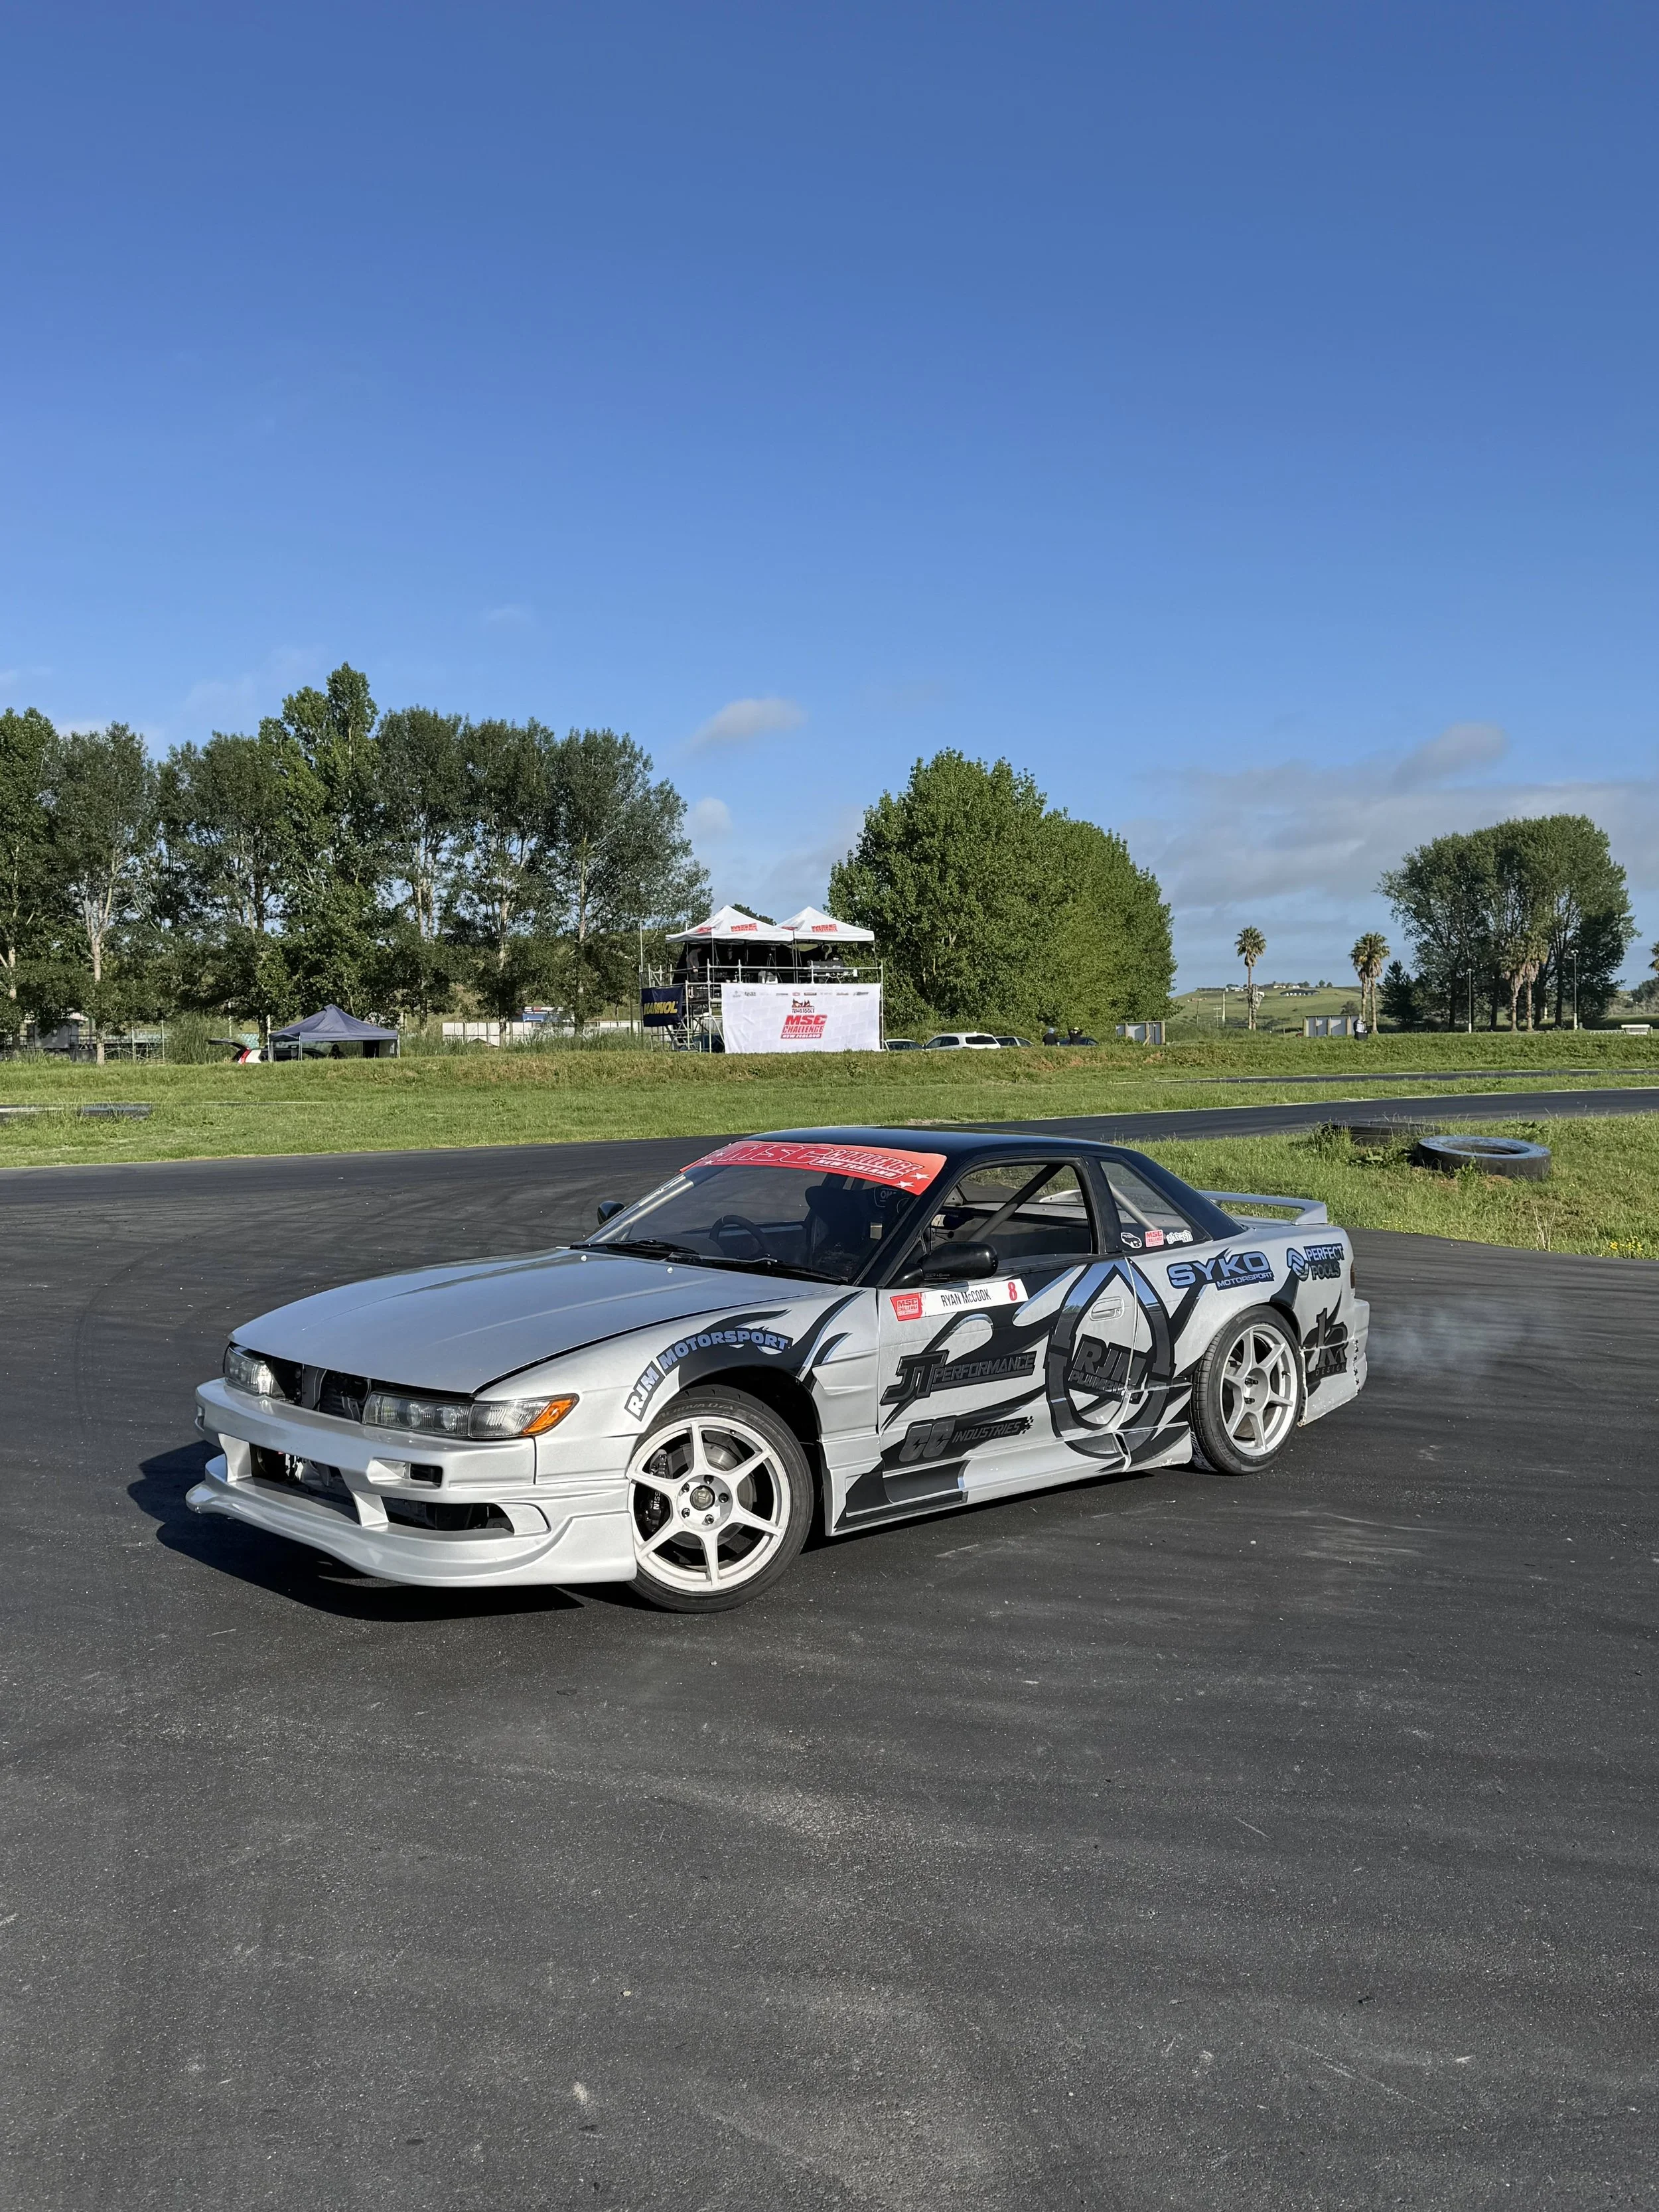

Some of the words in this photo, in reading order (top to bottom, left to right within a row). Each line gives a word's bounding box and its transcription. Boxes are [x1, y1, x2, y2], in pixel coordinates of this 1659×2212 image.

[785, 1015, 828, 1025] MSC
[717, 1145, 834, 1164] MSC
[826, 1149, 923, 1174] CHALLENGE
[816, 1158, 841, 1167] NEW
[843, 1162, 896, 1177] ZEALAND
[1307, 1246, 1343, 1262] PERFECT
[1168, 1250, 1270, 1286] SYKO
[1311, 1262, 1341, 1280] POOLS
[1217, 1272, 1273, 1288] MOTORSPORT
[897, 1299, 917, 1307] MSC
[941, 1294, 962, 1307] RYAN
[962, 1289, 991, 1304] McCOOK
[1007, 1282, 1018, 1301] 8
[933, 1354, 1037, 1383] PERFORMANCE
[1072, 1341, 1147, 1386] RJM
[627, 1366, 660, 1417] RJM
[658, 1331, 788, 1370] MOTORSPORT
[952, 1421, 1023, 1443] INDUSTRIES
